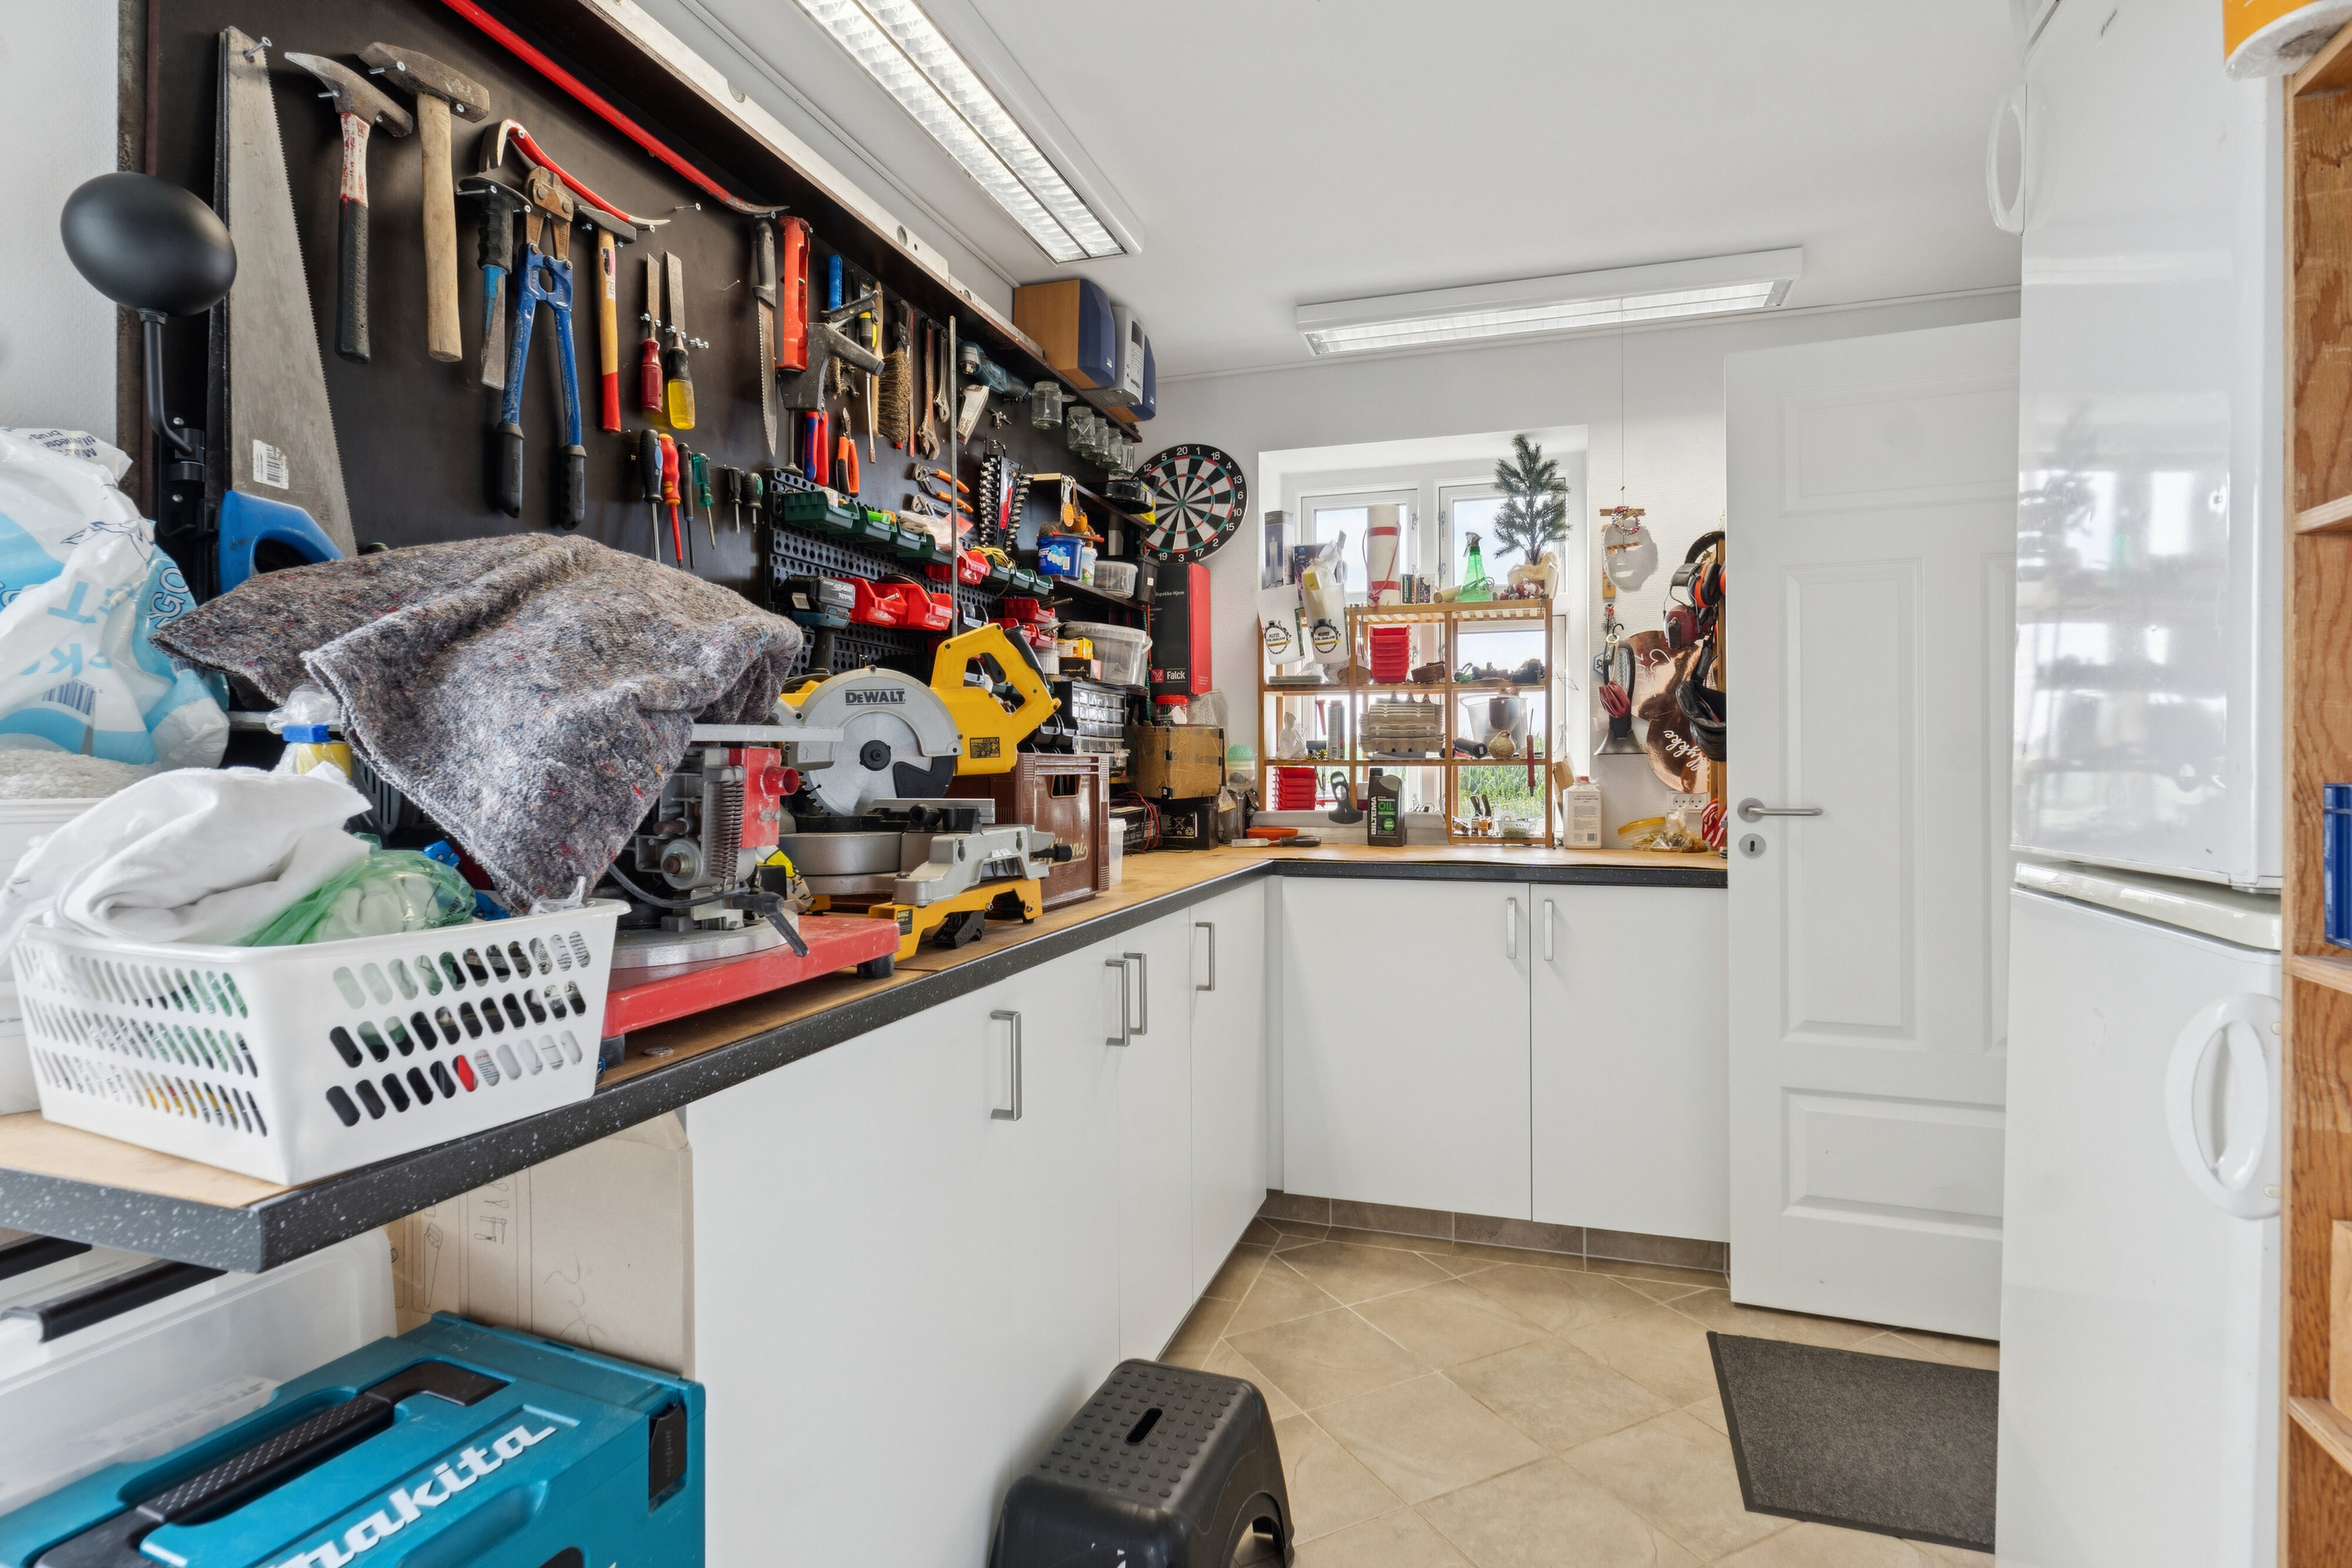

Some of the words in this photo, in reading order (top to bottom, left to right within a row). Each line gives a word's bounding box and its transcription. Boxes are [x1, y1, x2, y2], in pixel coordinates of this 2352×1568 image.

[1177, 446, 1188, 456] 20
[1211, 452, 1221, 460] 18
[1233, 475, 1243, 484] 13
[1233, 508, 1243, 517] 10
[1225, 523, 1235, 532] 15
[1195, 548, 1204, 557] 17
[1167, 670, 1185, 680] Falck
[1377, 802, 1394, 811] OIL
